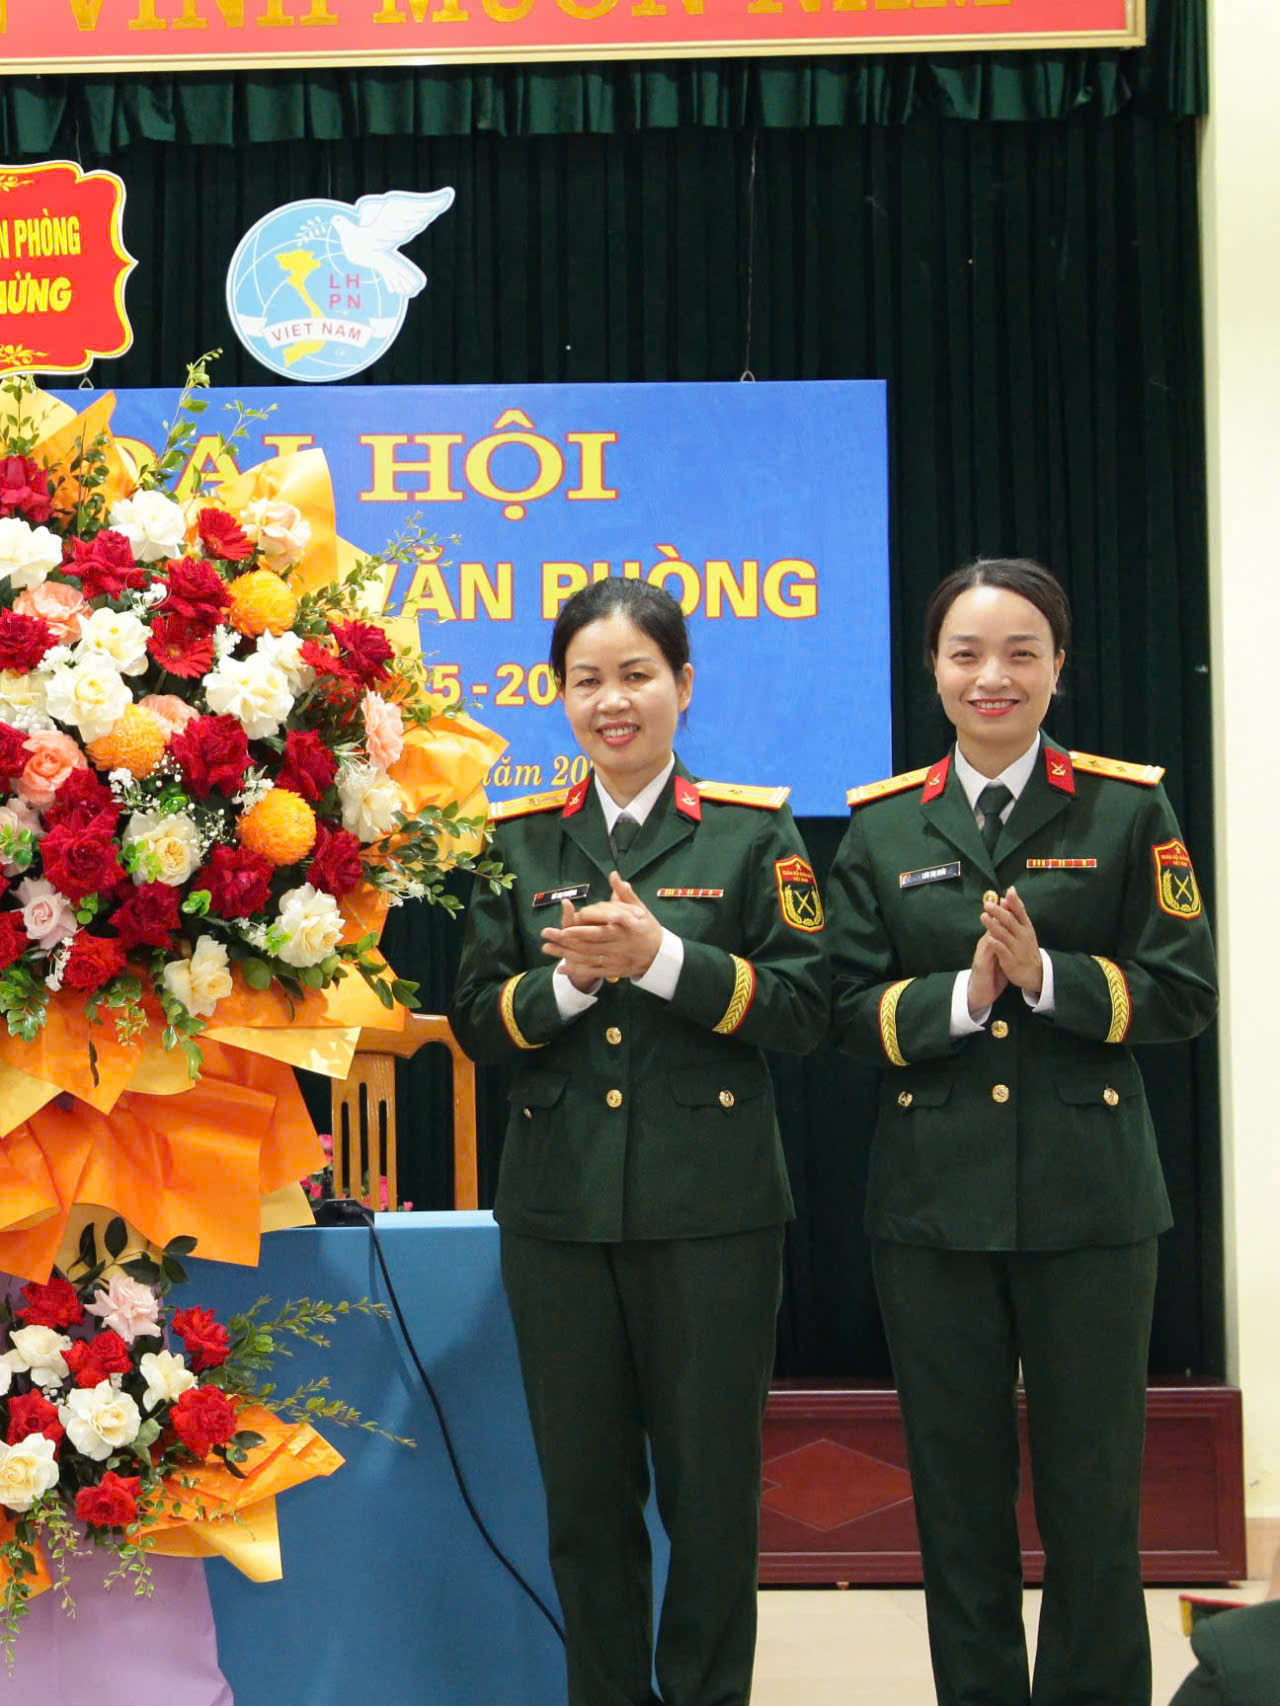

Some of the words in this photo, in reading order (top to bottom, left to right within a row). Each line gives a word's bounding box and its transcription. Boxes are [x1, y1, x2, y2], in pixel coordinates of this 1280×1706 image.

[15, 208, 81, 256] PHÒNG
[322, 322, 362, 341] NAM
[358, 408, 618, 521] HỘI
